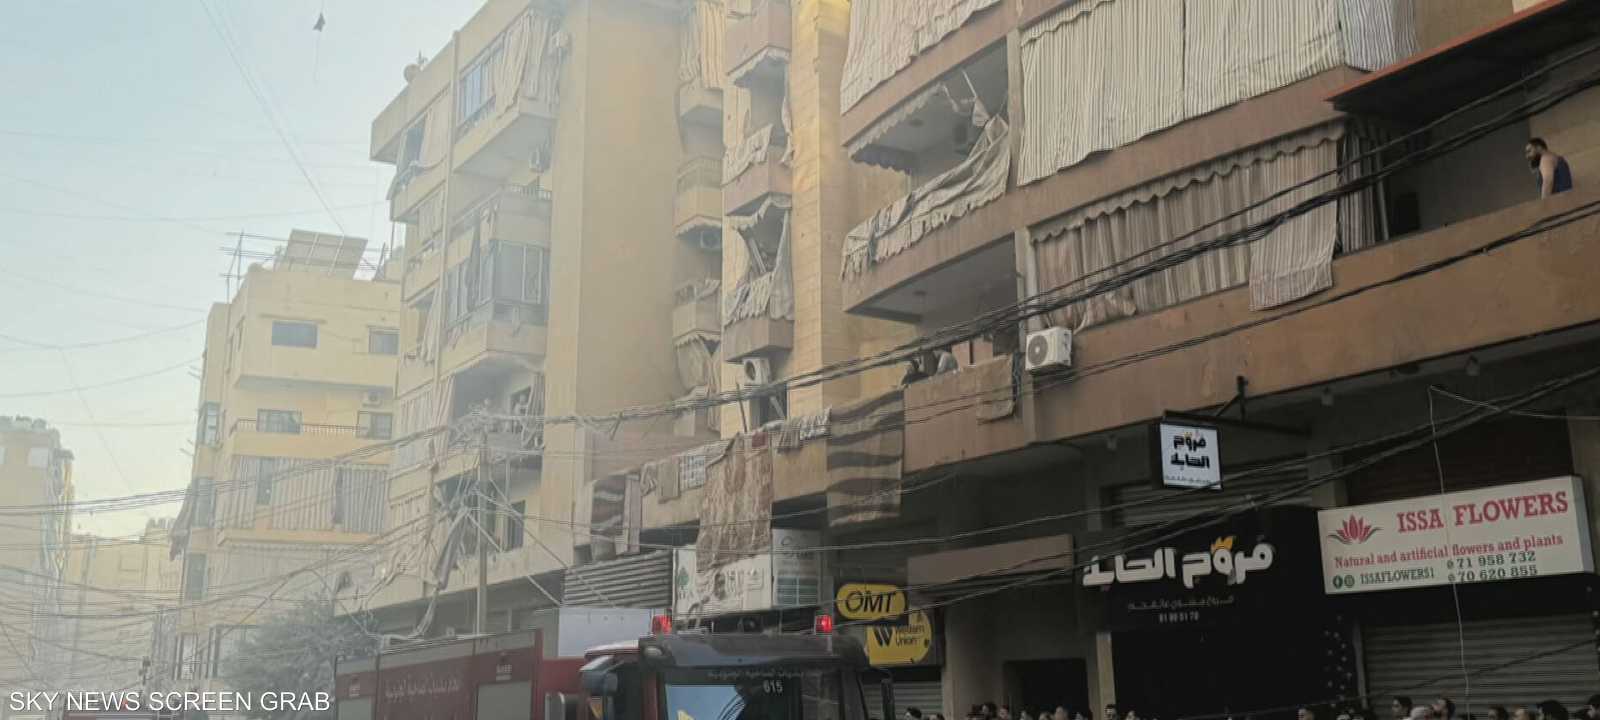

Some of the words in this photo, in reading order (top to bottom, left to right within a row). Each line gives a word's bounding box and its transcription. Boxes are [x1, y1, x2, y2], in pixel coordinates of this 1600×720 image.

[1397, 508, 1444, 533] ISSA
[1454, 491, 1568, 526] FLOWERS
[1182, 537, 1273, 588] فروج
[1335, 552, 1374, 568] Natural
[1377, 549, 1397, 564] and
[1400, 543, 1448, 562] artificial
[1453, 543, 1495, 556] flowers
[1498, 537, 1520, 552] and
[1525, 534, 1563, 550] plants
[1457, 558, 1472, 569] 71
[1478, 554, 1504, 567] 958
[1509, 551, 1536, 564] 732
[1458, 570, 1475, 582] 70
[1480, 567, 1506, 580] 620
[1511, 565, 1537, 577] 855
[845, 589, 897, 613] OMT
